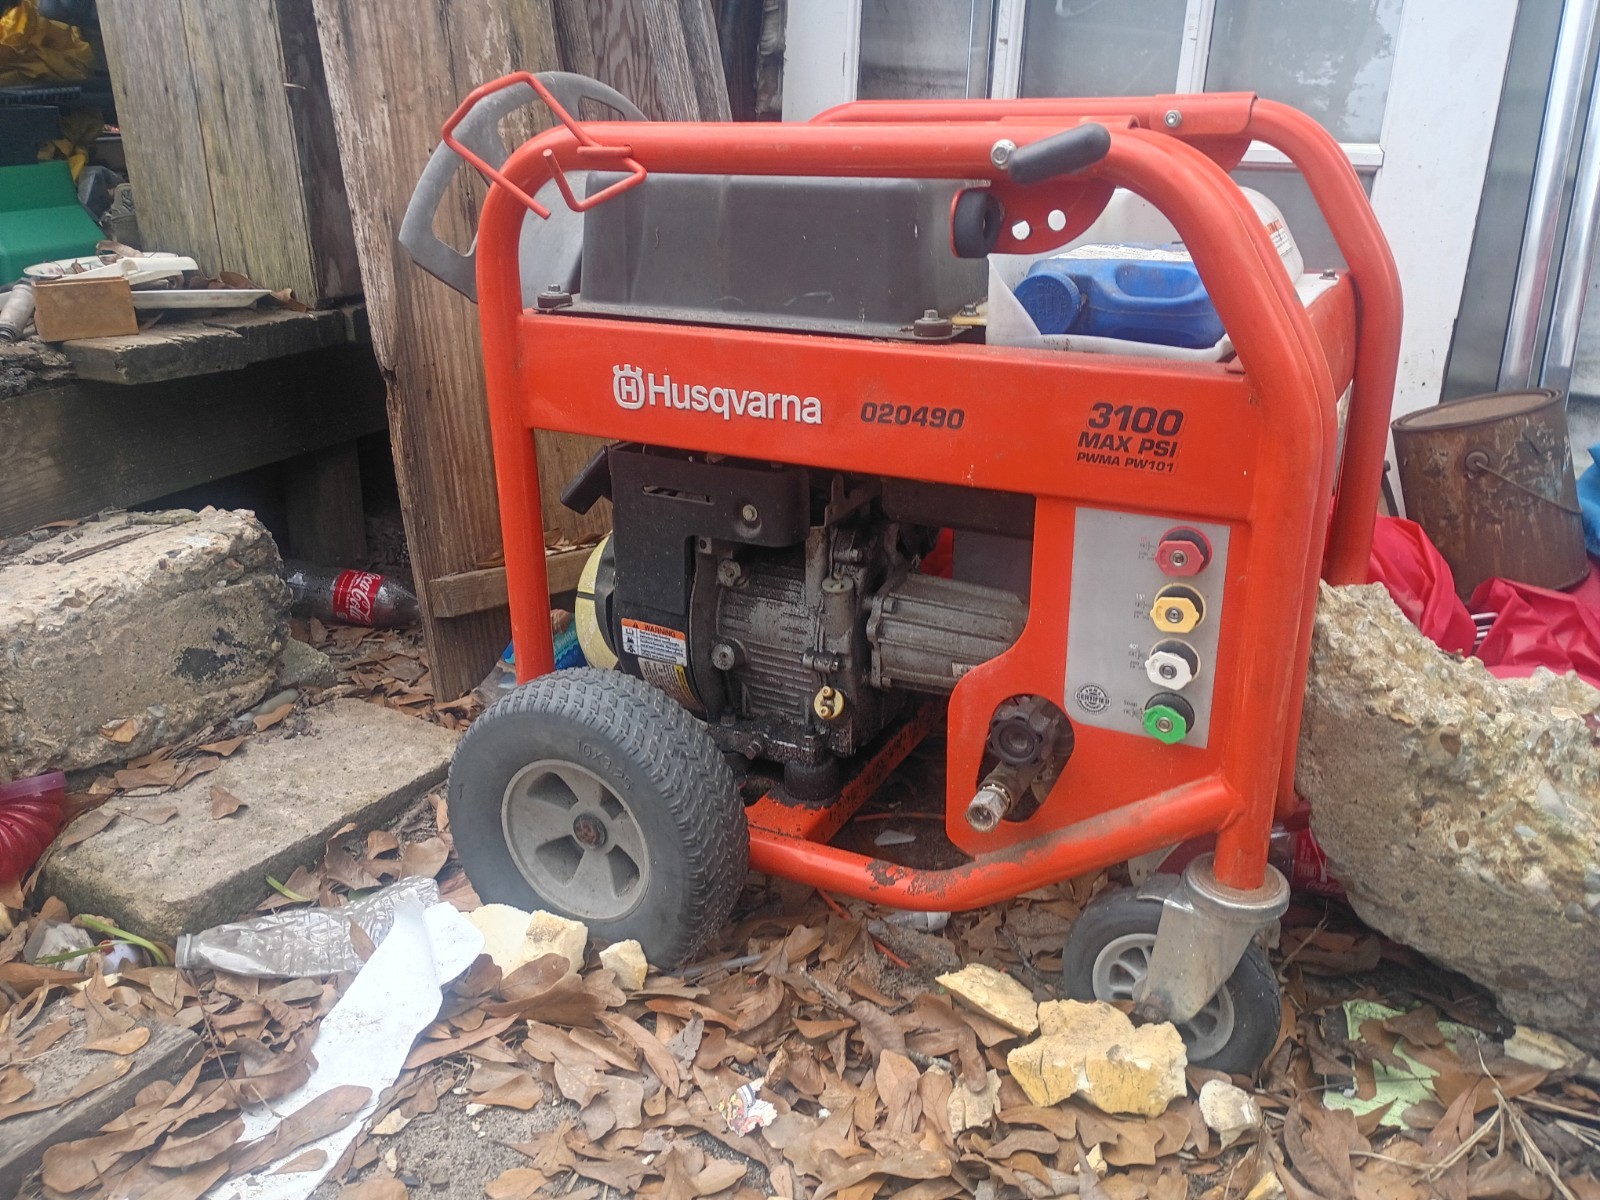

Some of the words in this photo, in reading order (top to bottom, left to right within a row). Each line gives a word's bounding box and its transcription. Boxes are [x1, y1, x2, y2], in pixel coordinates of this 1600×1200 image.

[647, 373, 823, 425] Husqvarna
[860, 401, 966, 430] 020490
[1087, 402, 1185, 437] 3100
[1077, 431, 1132, 453] MAX
[1138, 438, 1179, 459] PSI
[1076, 452, 1121, 467] PWMA
[1124, 458, 1175, 474] PW101
[643, 624, 676, 638] WARNING
[1076, 691, 1110, 706] CERTIFIED
